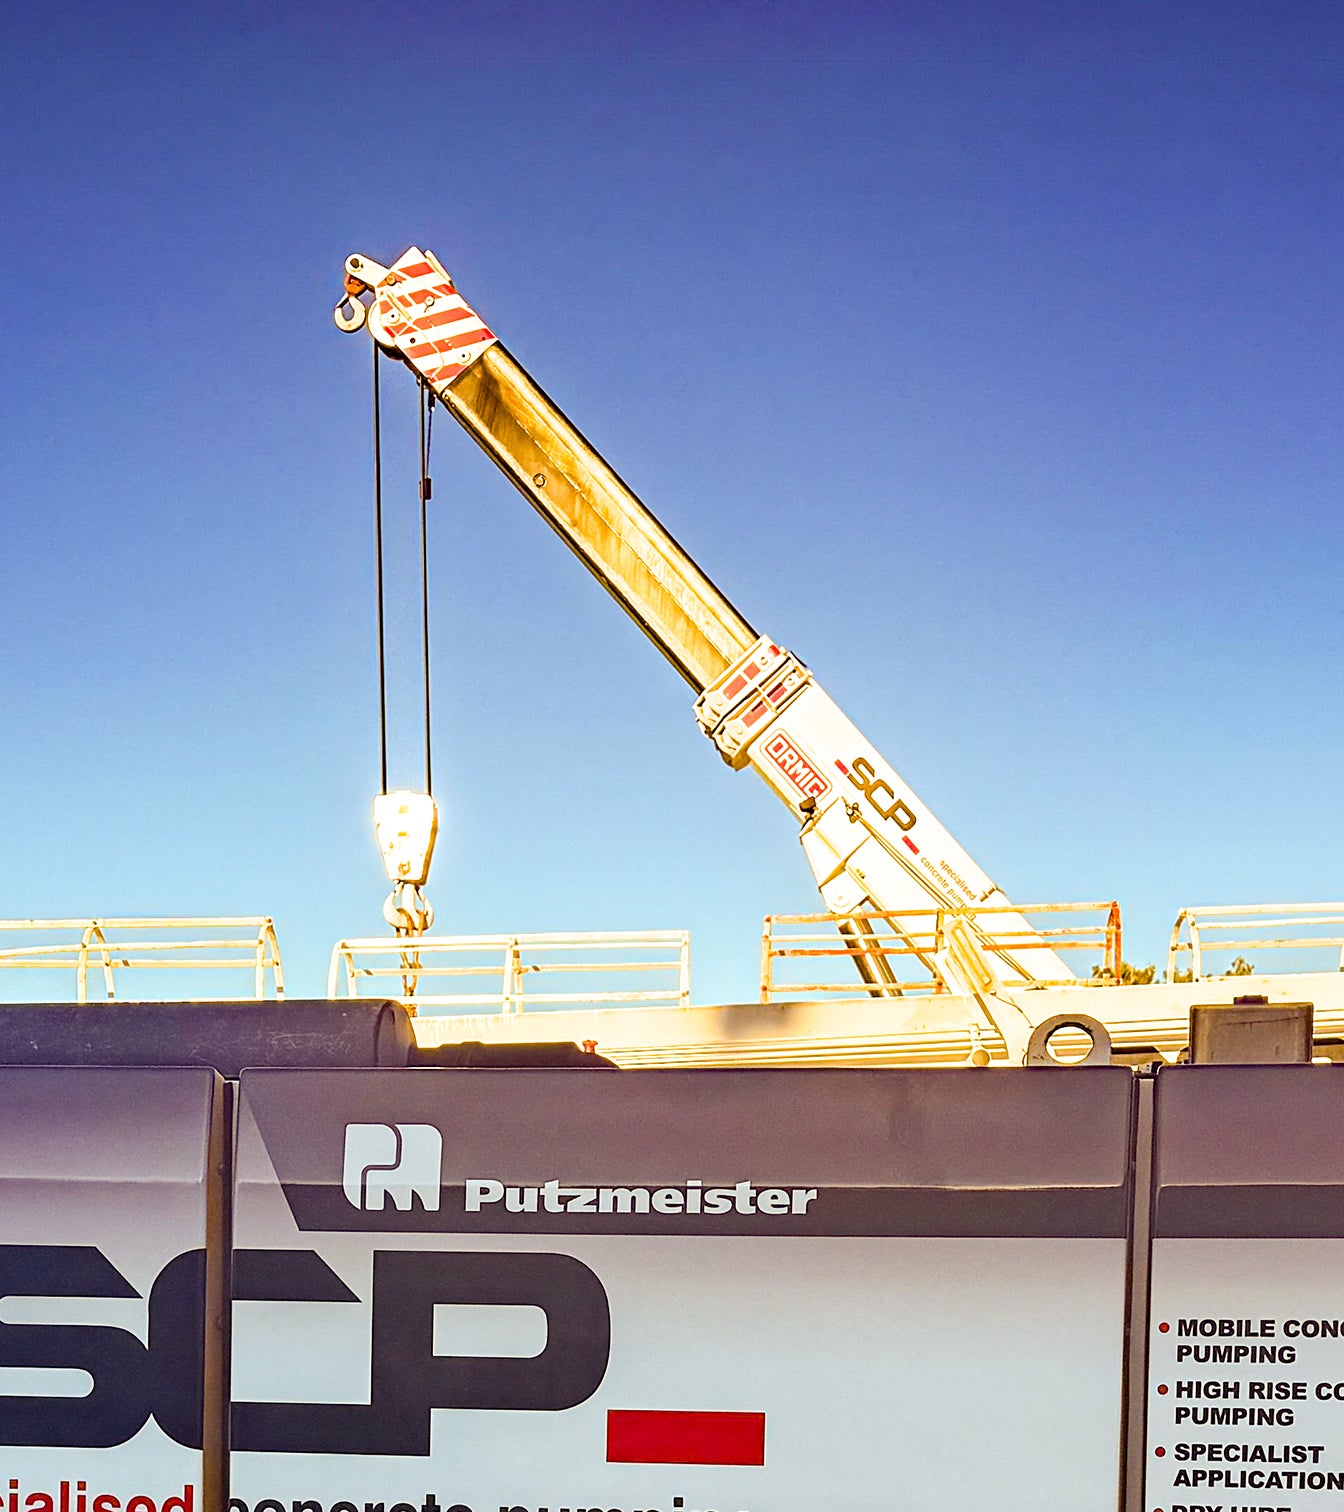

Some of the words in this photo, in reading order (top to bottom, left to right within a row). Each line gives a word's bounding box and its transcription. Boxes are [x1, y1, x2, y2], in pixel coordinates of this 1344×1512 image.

[767, 735, 826, 798] ORMIG
[846, 757, 917, 831] SCP
[920, 856, 949, 889] concrete
[938, 859, 977, 901] specialised
[460, 1179, 822, 1216] Putzmeister
[1176, 1318, 1276, 1338] MOBILE
[1175, 1344, 1296, 1364] PUMPING
[1175, 1380, 1240, 1400] HIGH
[1248, 1381, 1308, 1401] RISE
[1174, 1406, 1295, 1427] PUMPING
[1173, 1443, 1325, 1464] SPECIALIST
